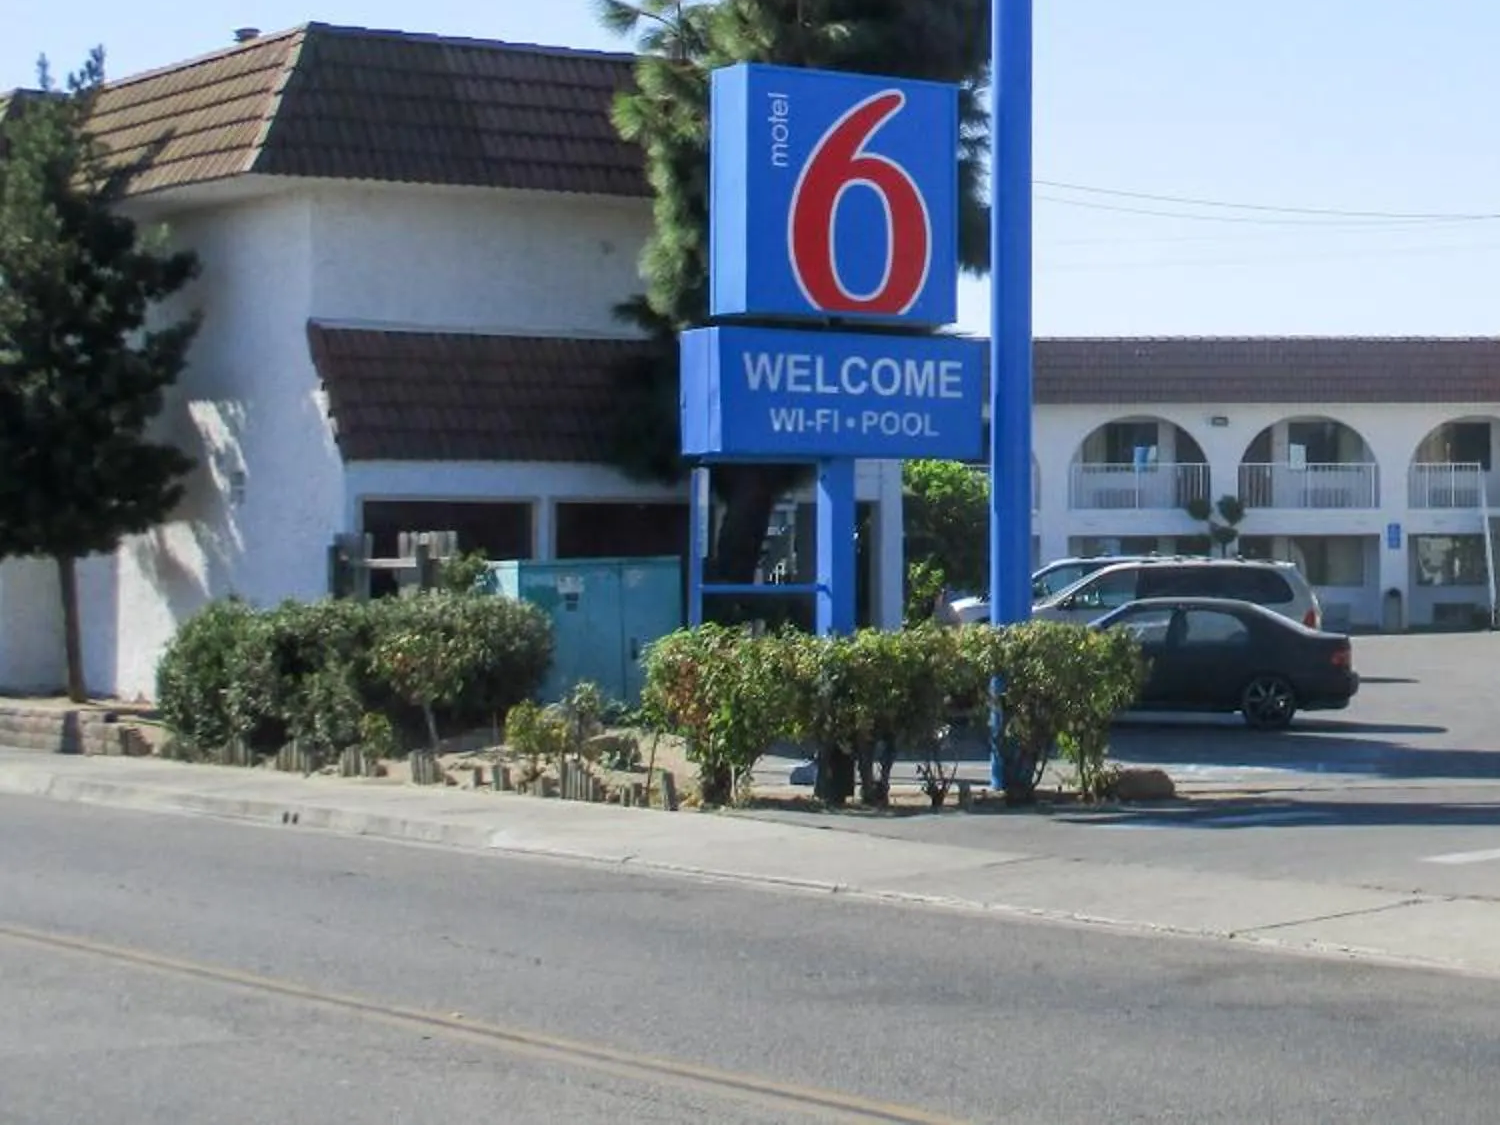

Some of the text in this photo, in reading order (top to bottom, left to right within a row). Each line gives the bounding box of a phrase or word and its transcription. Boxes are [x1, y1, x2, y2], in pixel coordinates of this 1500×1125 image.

[768, 89, 932, 315] motel 6
[743, 352, 963, 398] WELCOME
[769, 408, 939, 437] WI-FI POOL
